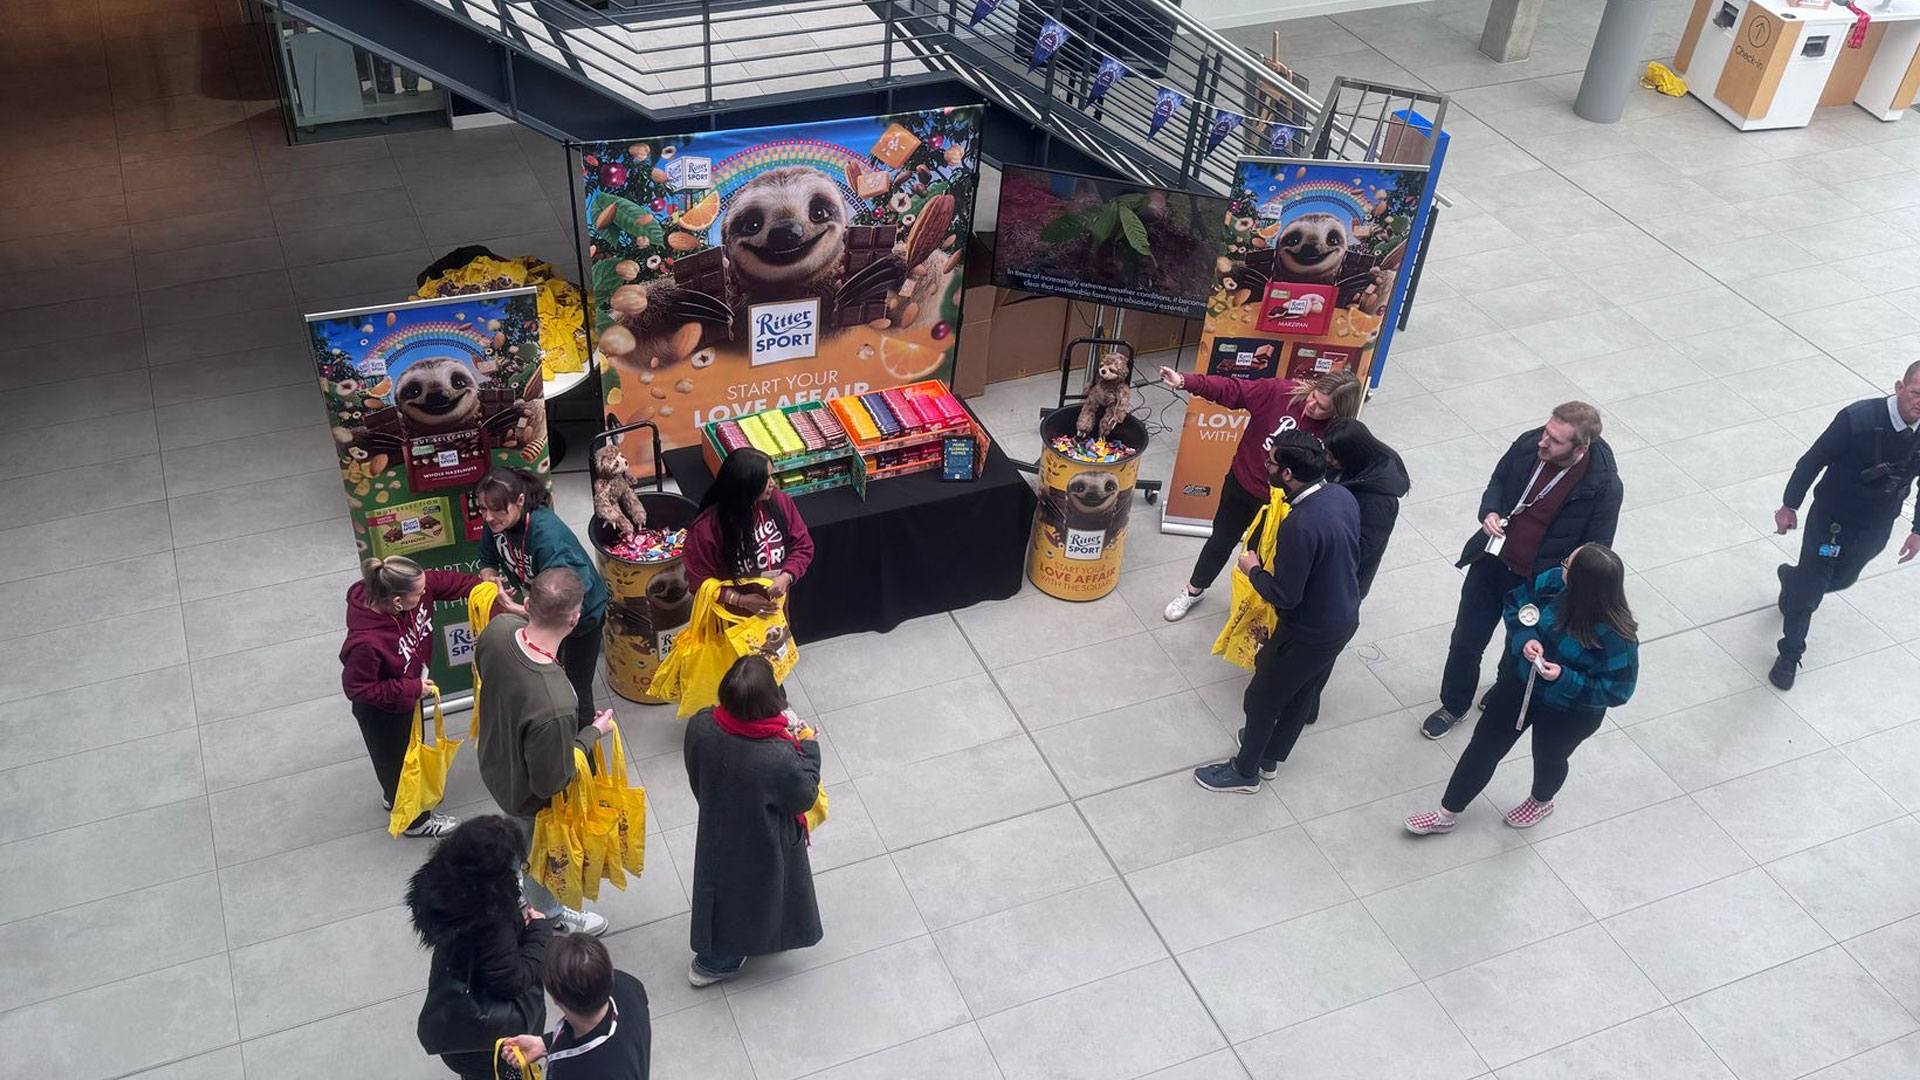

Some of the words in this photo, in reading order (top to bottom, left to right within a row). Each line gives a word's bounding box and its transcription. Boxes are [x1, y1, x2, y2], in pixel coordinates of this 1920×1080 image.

[1735, 45, 1763, 70] Check-in
[1040, 274, 1080, 288] increasingly
[1080, 282, 1108, 291] extreme
[1108, 286, 1136, 296] weather
[1054, 286, 1092, 297] sustainable
[1092, 291, 1117, 302] farming
[1124, 297, 1159, 309] absolutely
[756, 310, 813, 338] Ritter
[756, 333, 812, 353] SPORT
[727, 378, 780, 400] START
[786, 370, 838, 390] YOUR
[1199, 430, 1237, 442] WITH
[1068, 546, 1100, 554] SPORT
[1070, 534, 1101, 546] Ritter
[1040, 562, 1071, 582] LOVE
[1074, 567, 1116, 583] AFFAIR
[1054, 562, 1078, 572] START
[1082, 564, 1106, 573] YOUR
[1041, 574, 1061, 587] WITH
[1064, 583, 1081, 592] THE
